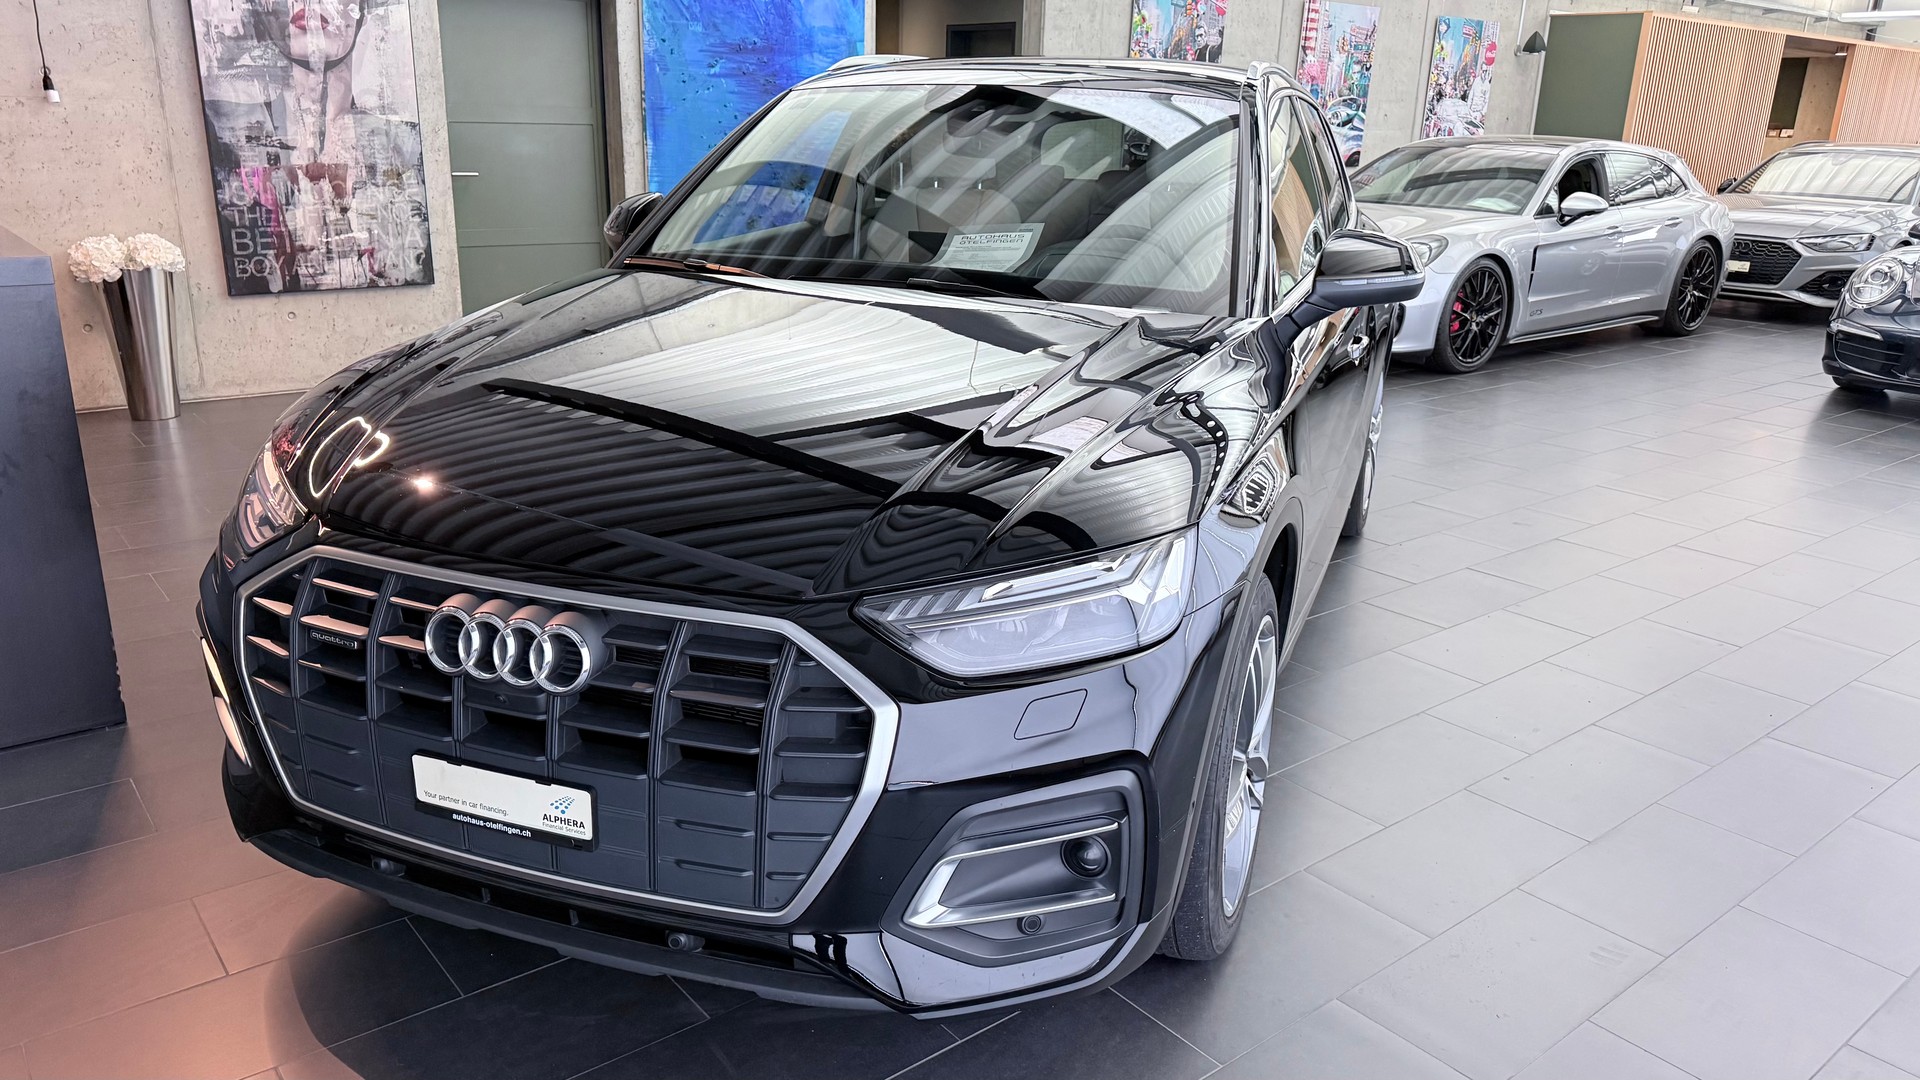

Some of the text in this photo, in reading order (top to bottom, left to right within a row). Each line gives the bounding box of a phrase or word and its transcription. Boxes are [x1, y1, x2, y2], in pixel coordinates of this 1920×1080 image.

[227, 205, 278, 227] THE
[234, 255, 285, 279] BOY
[1529, 308, 1543, 317] GTS
[311, 632, 354, 648] quattro
[423, 790, 437, 799] Your
[438, 794, 460, 805] partner
[461, 799, 467, 807] in
[479, 803, 509, 817] financing.
[452, 813, 532, 838] autohaus-otelfingen.ch
[542, 813, 586, 830] ALPHERA
[542, 821, 586, 836] Financial Services
